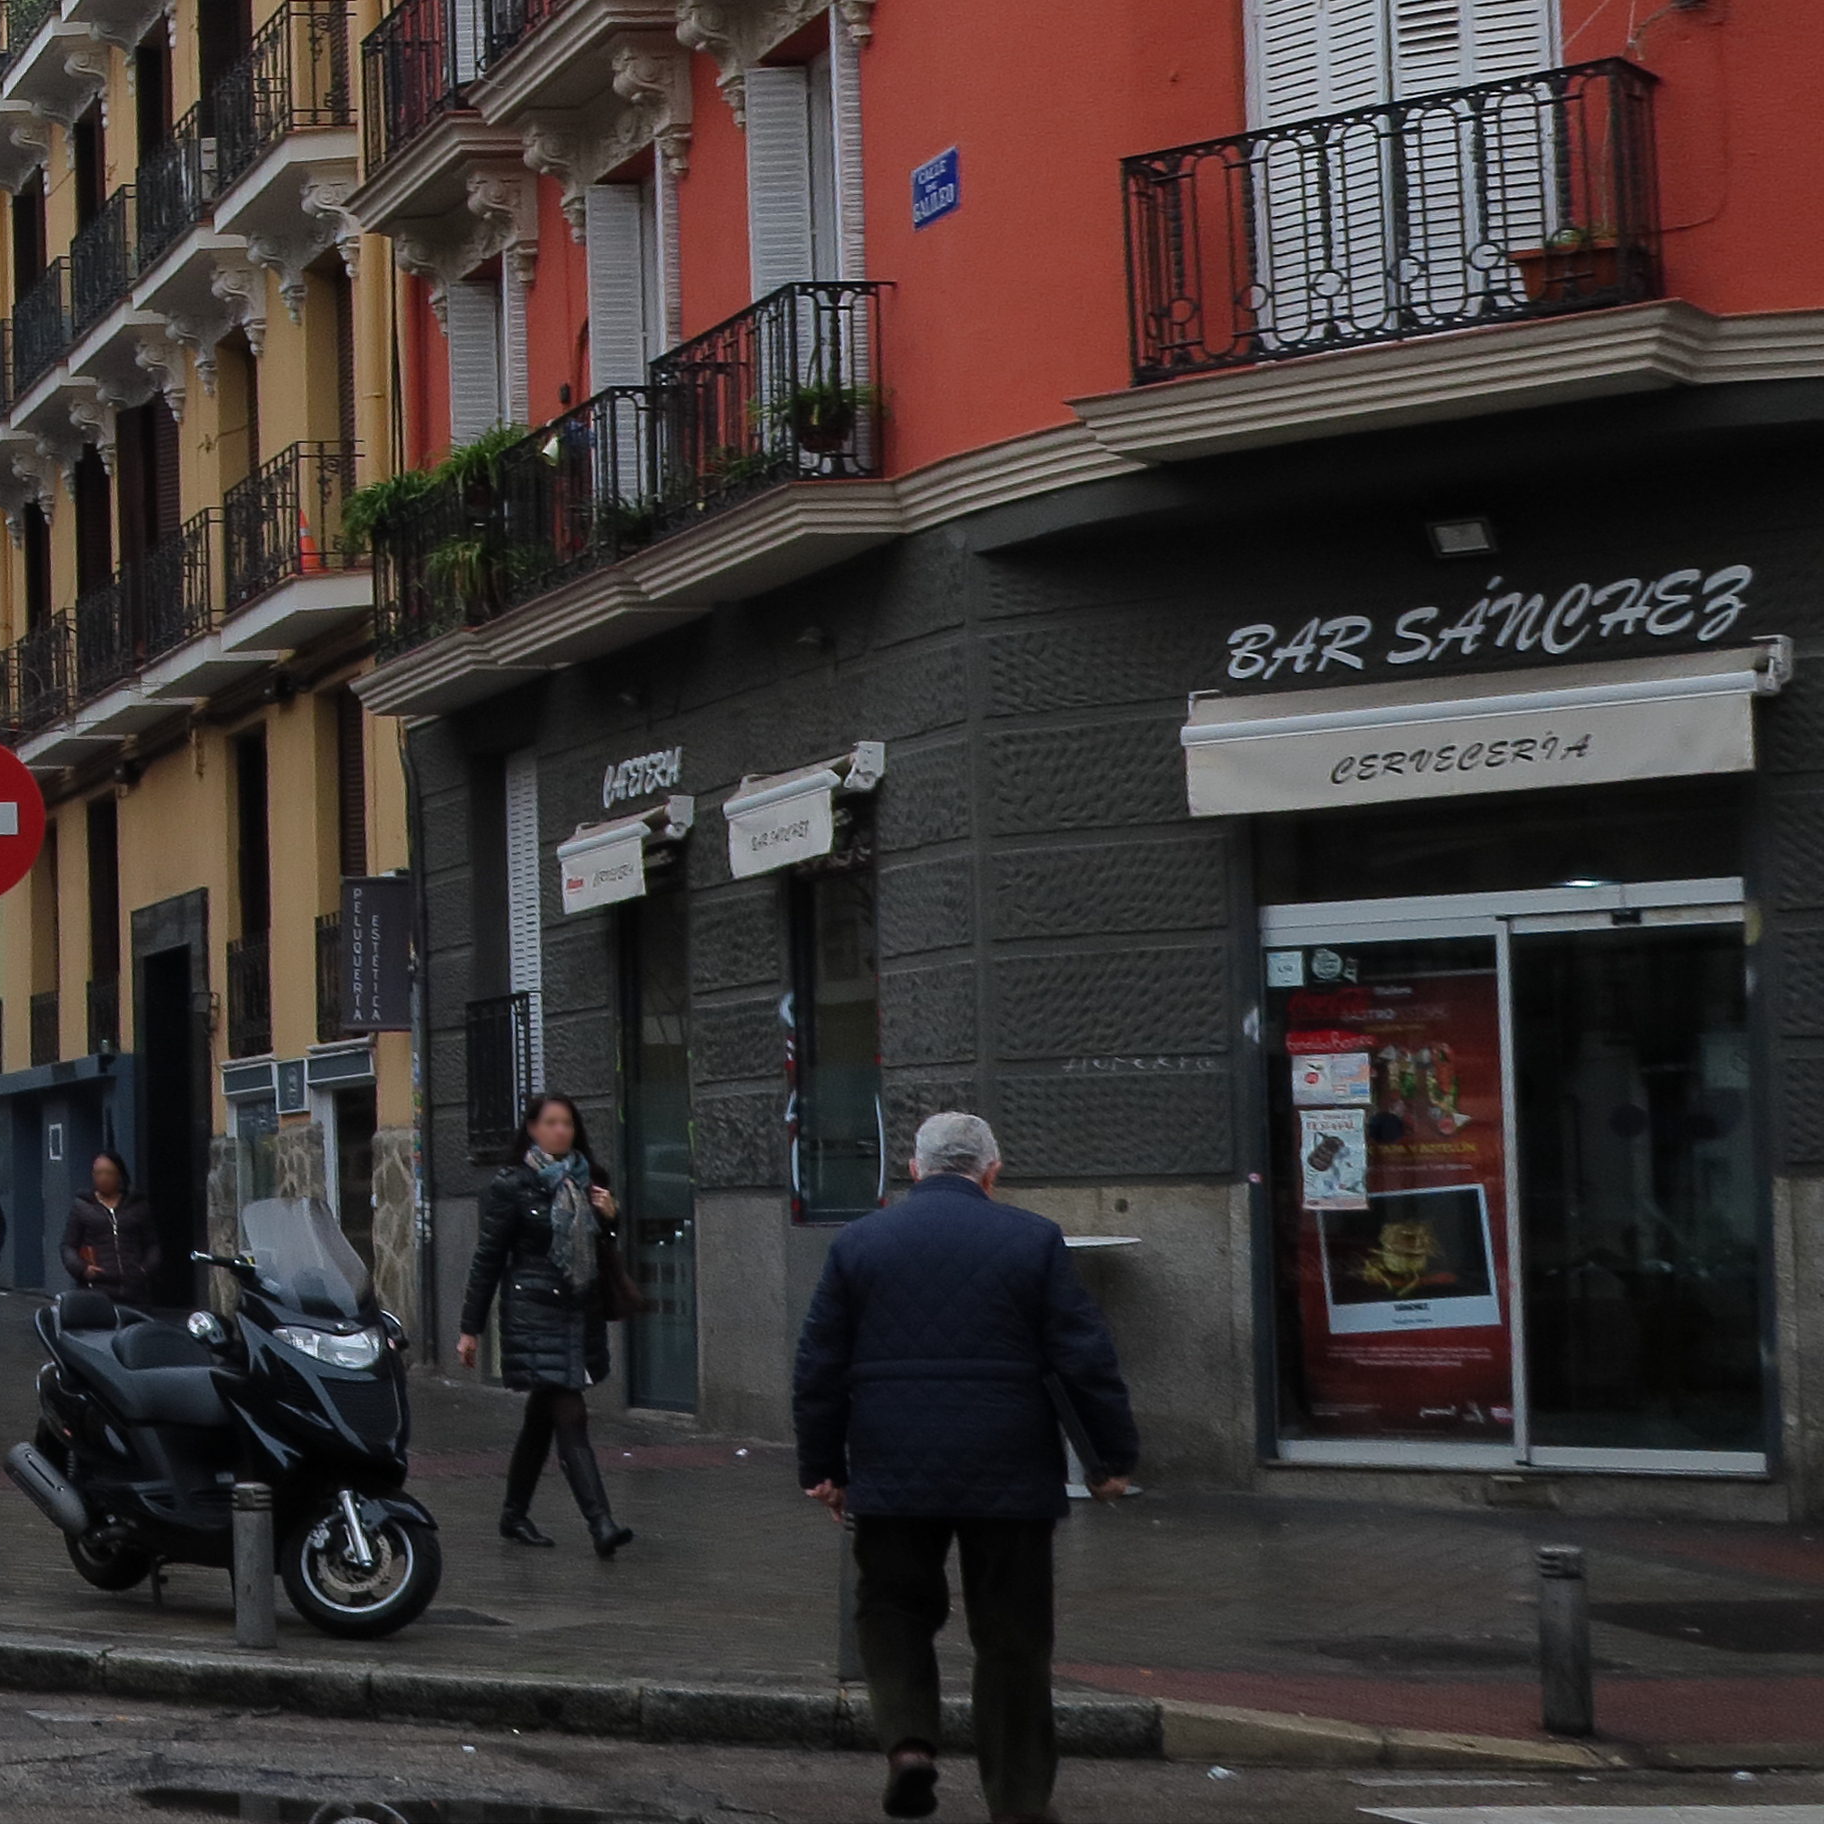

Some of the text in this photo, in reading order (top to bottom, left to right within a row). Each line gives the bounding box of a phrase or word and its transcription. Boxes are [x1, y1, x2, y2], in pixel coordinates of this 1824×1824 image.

[913, 183, 955, 223] GALILEO
[1226, 565, 1754, 680] BAR SÁNCHEZ
[1331, 731, 1593, 784] CERVECERÍA
